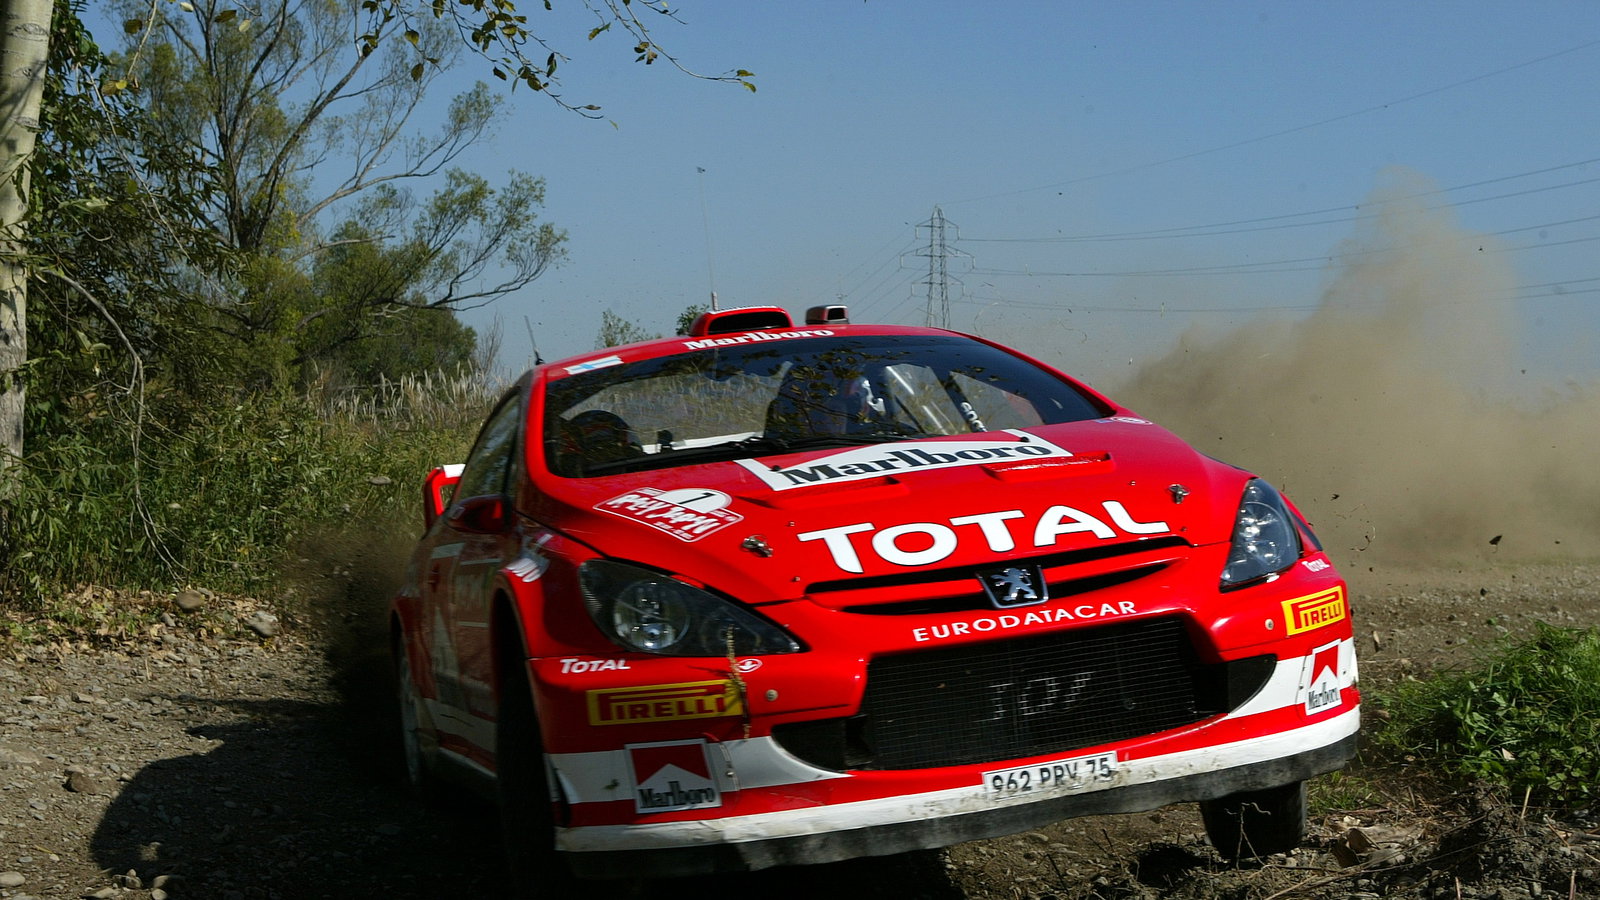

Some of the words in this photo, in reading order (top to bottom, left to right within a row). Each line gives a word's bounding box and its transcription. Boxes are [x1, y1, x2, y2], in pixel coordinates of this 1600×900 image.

[683, 329, 834, 350] Marlboro
[779, 444, 1053, 486] Marlboro
[678, 492, 715, 505] 1
[797, 501, 1170, 573] TOTAL
[1302, 558, 1330, 573] TOTAL
[913, 600, 1137, 643] EURODATACAR
[1291, 591, 1342, 630] PIRELLI
[560, 659, 631, 674] TOTAL
[597, 684, 728, 721] PIRELLI
[1308, 682, 1338, 710] Marlboro
[992, 770, 1031, 793] 962
[1086, 757, 1112, 780] 75
[638, 781, 715, 808] Marlboro
